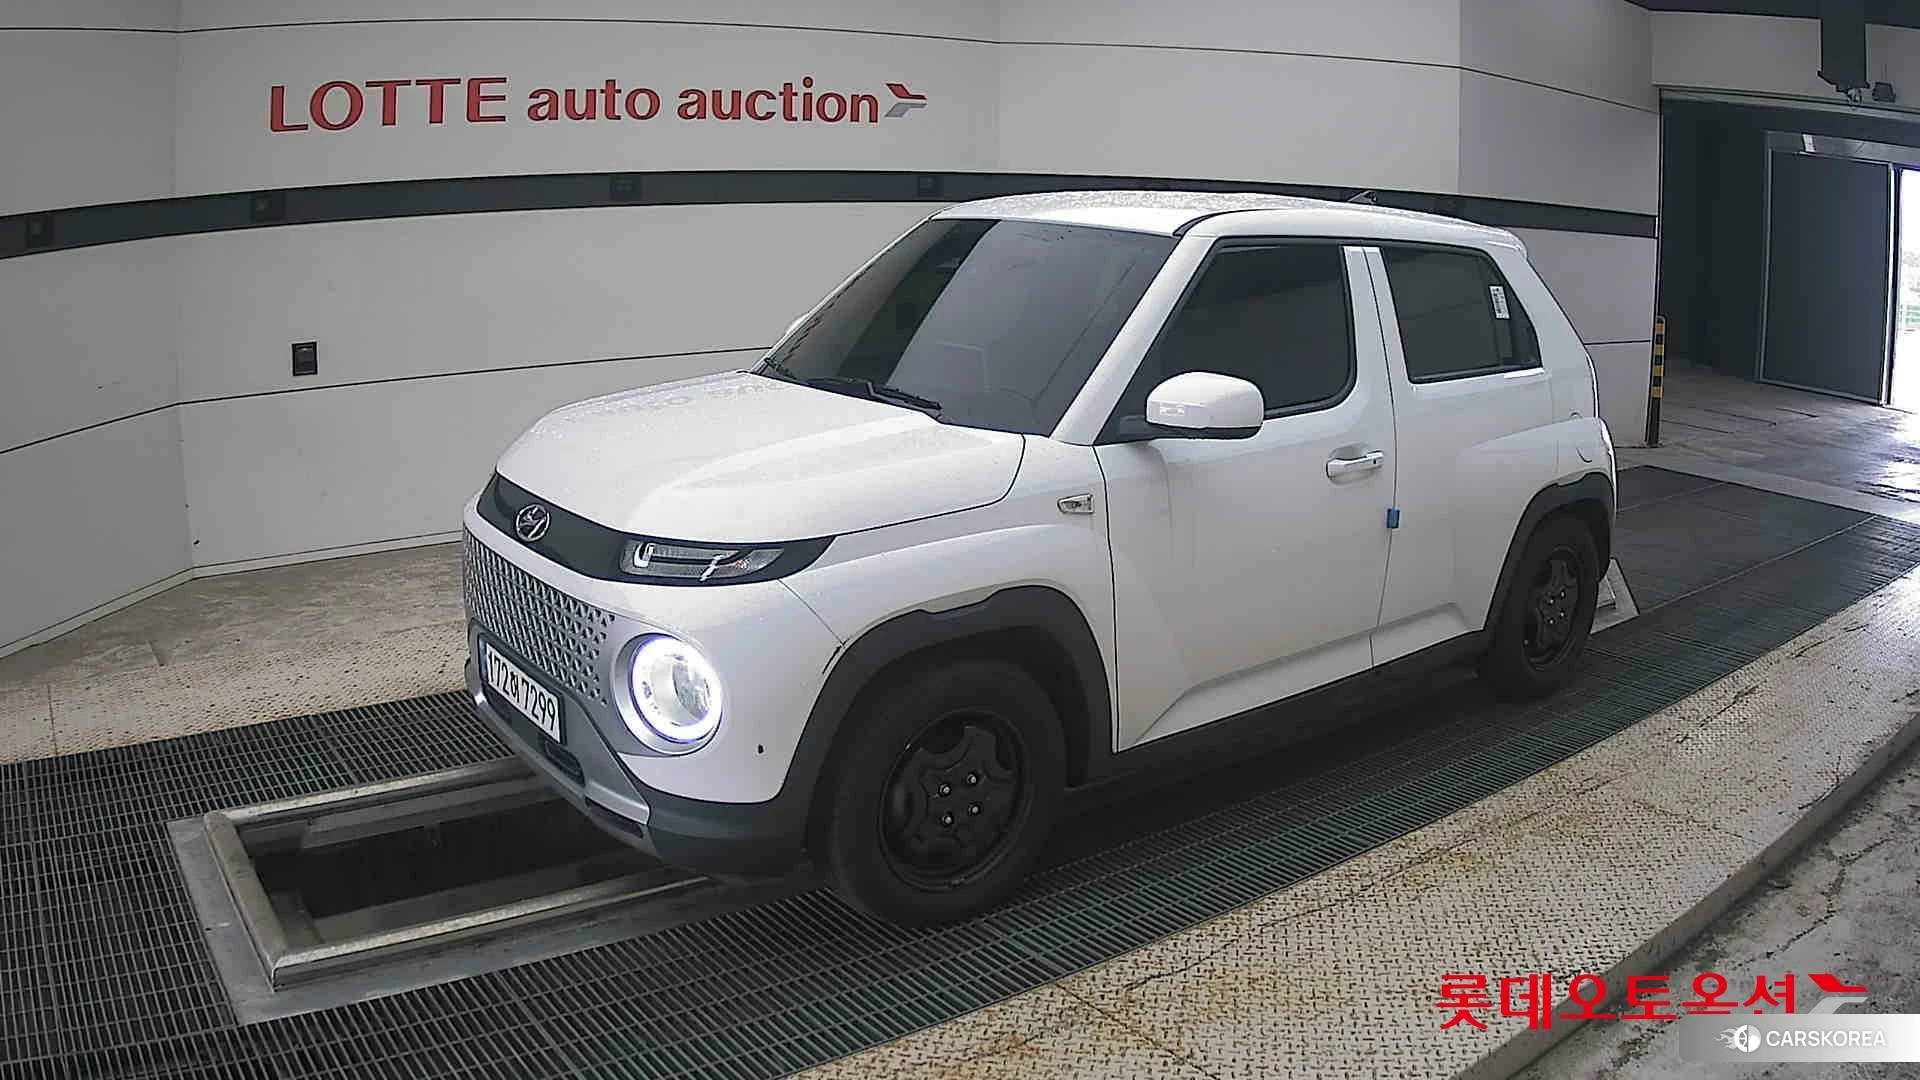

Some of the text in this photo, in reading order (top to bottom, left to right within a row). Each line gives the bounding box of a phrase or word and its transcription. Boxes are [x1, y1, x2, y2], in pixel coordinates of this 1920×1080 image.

[269, 77, 880, 132] LOTTE auto auction
[522, 678, 556, 731] 7299
